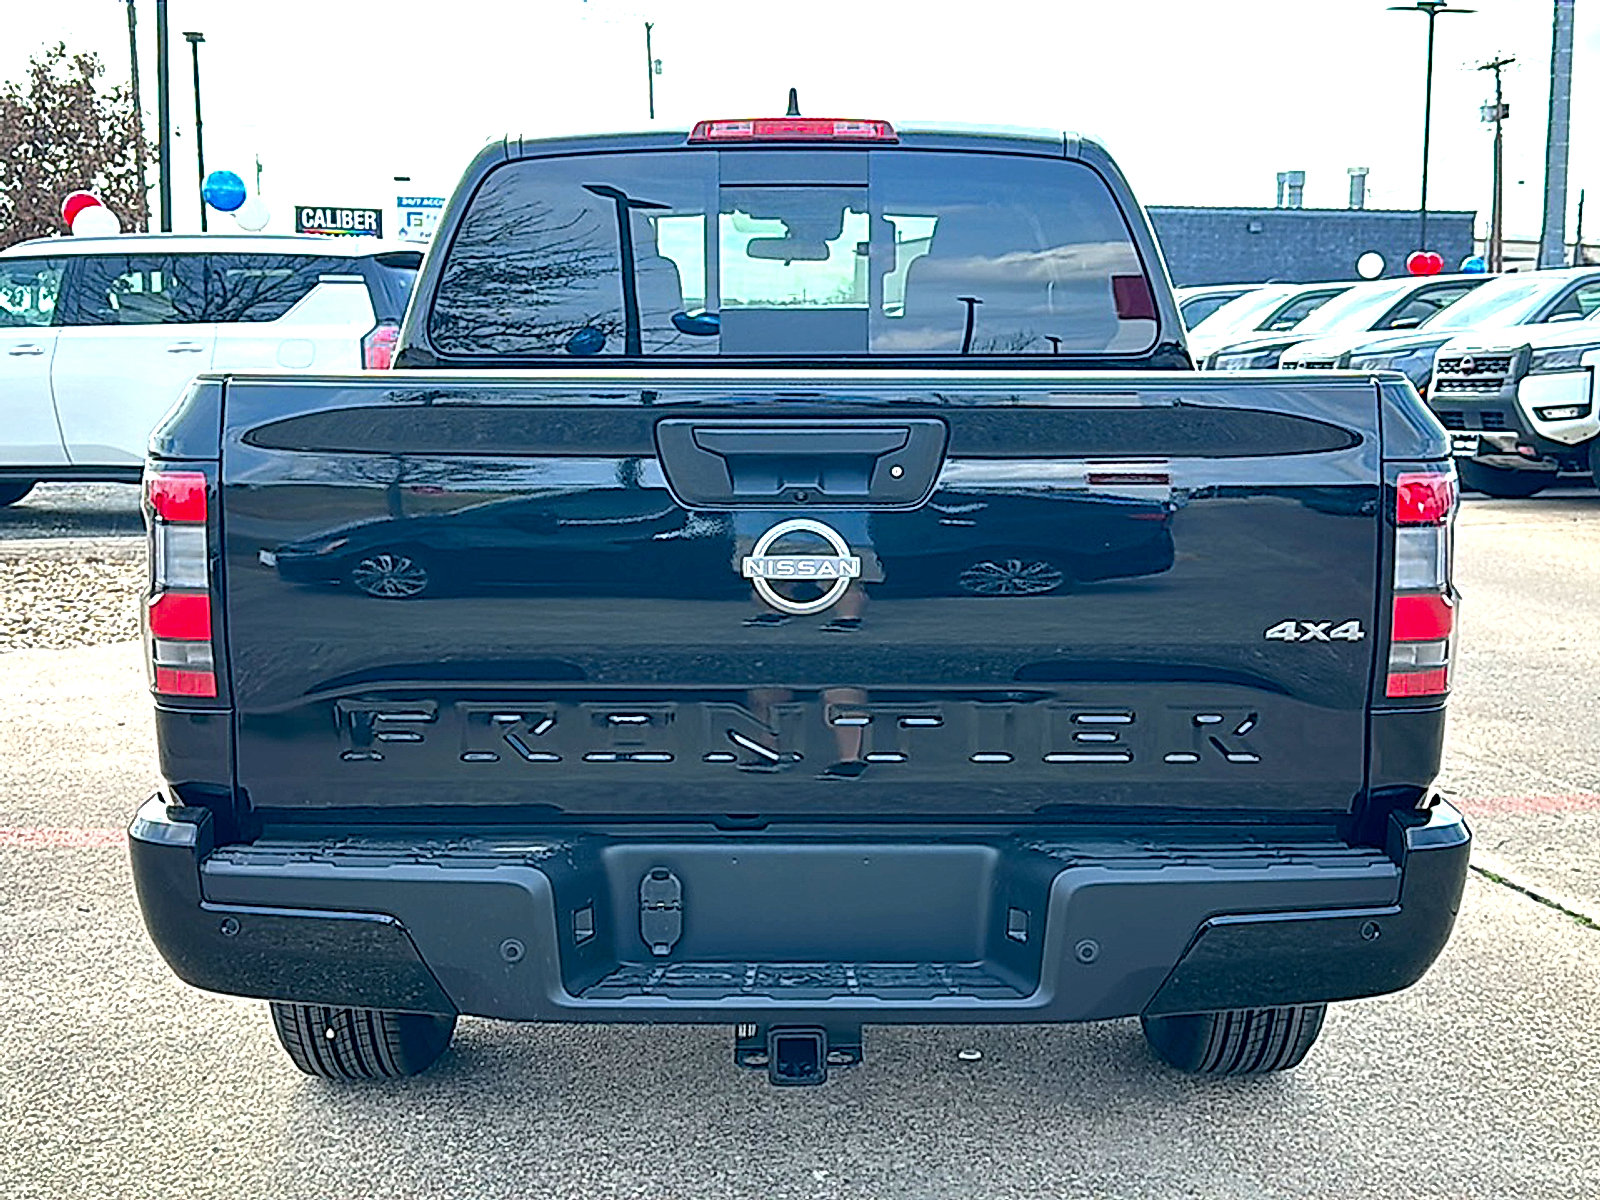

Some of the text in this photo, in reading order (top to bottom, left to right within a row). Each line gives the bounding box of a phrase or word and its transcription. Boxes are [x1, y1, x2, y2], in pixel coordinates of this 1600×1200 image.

[301, 208, 377, 230] CALIBER
[748, 559, 857, 576] NISSAN
[335, 701, 1261, 764] FRONTIER
